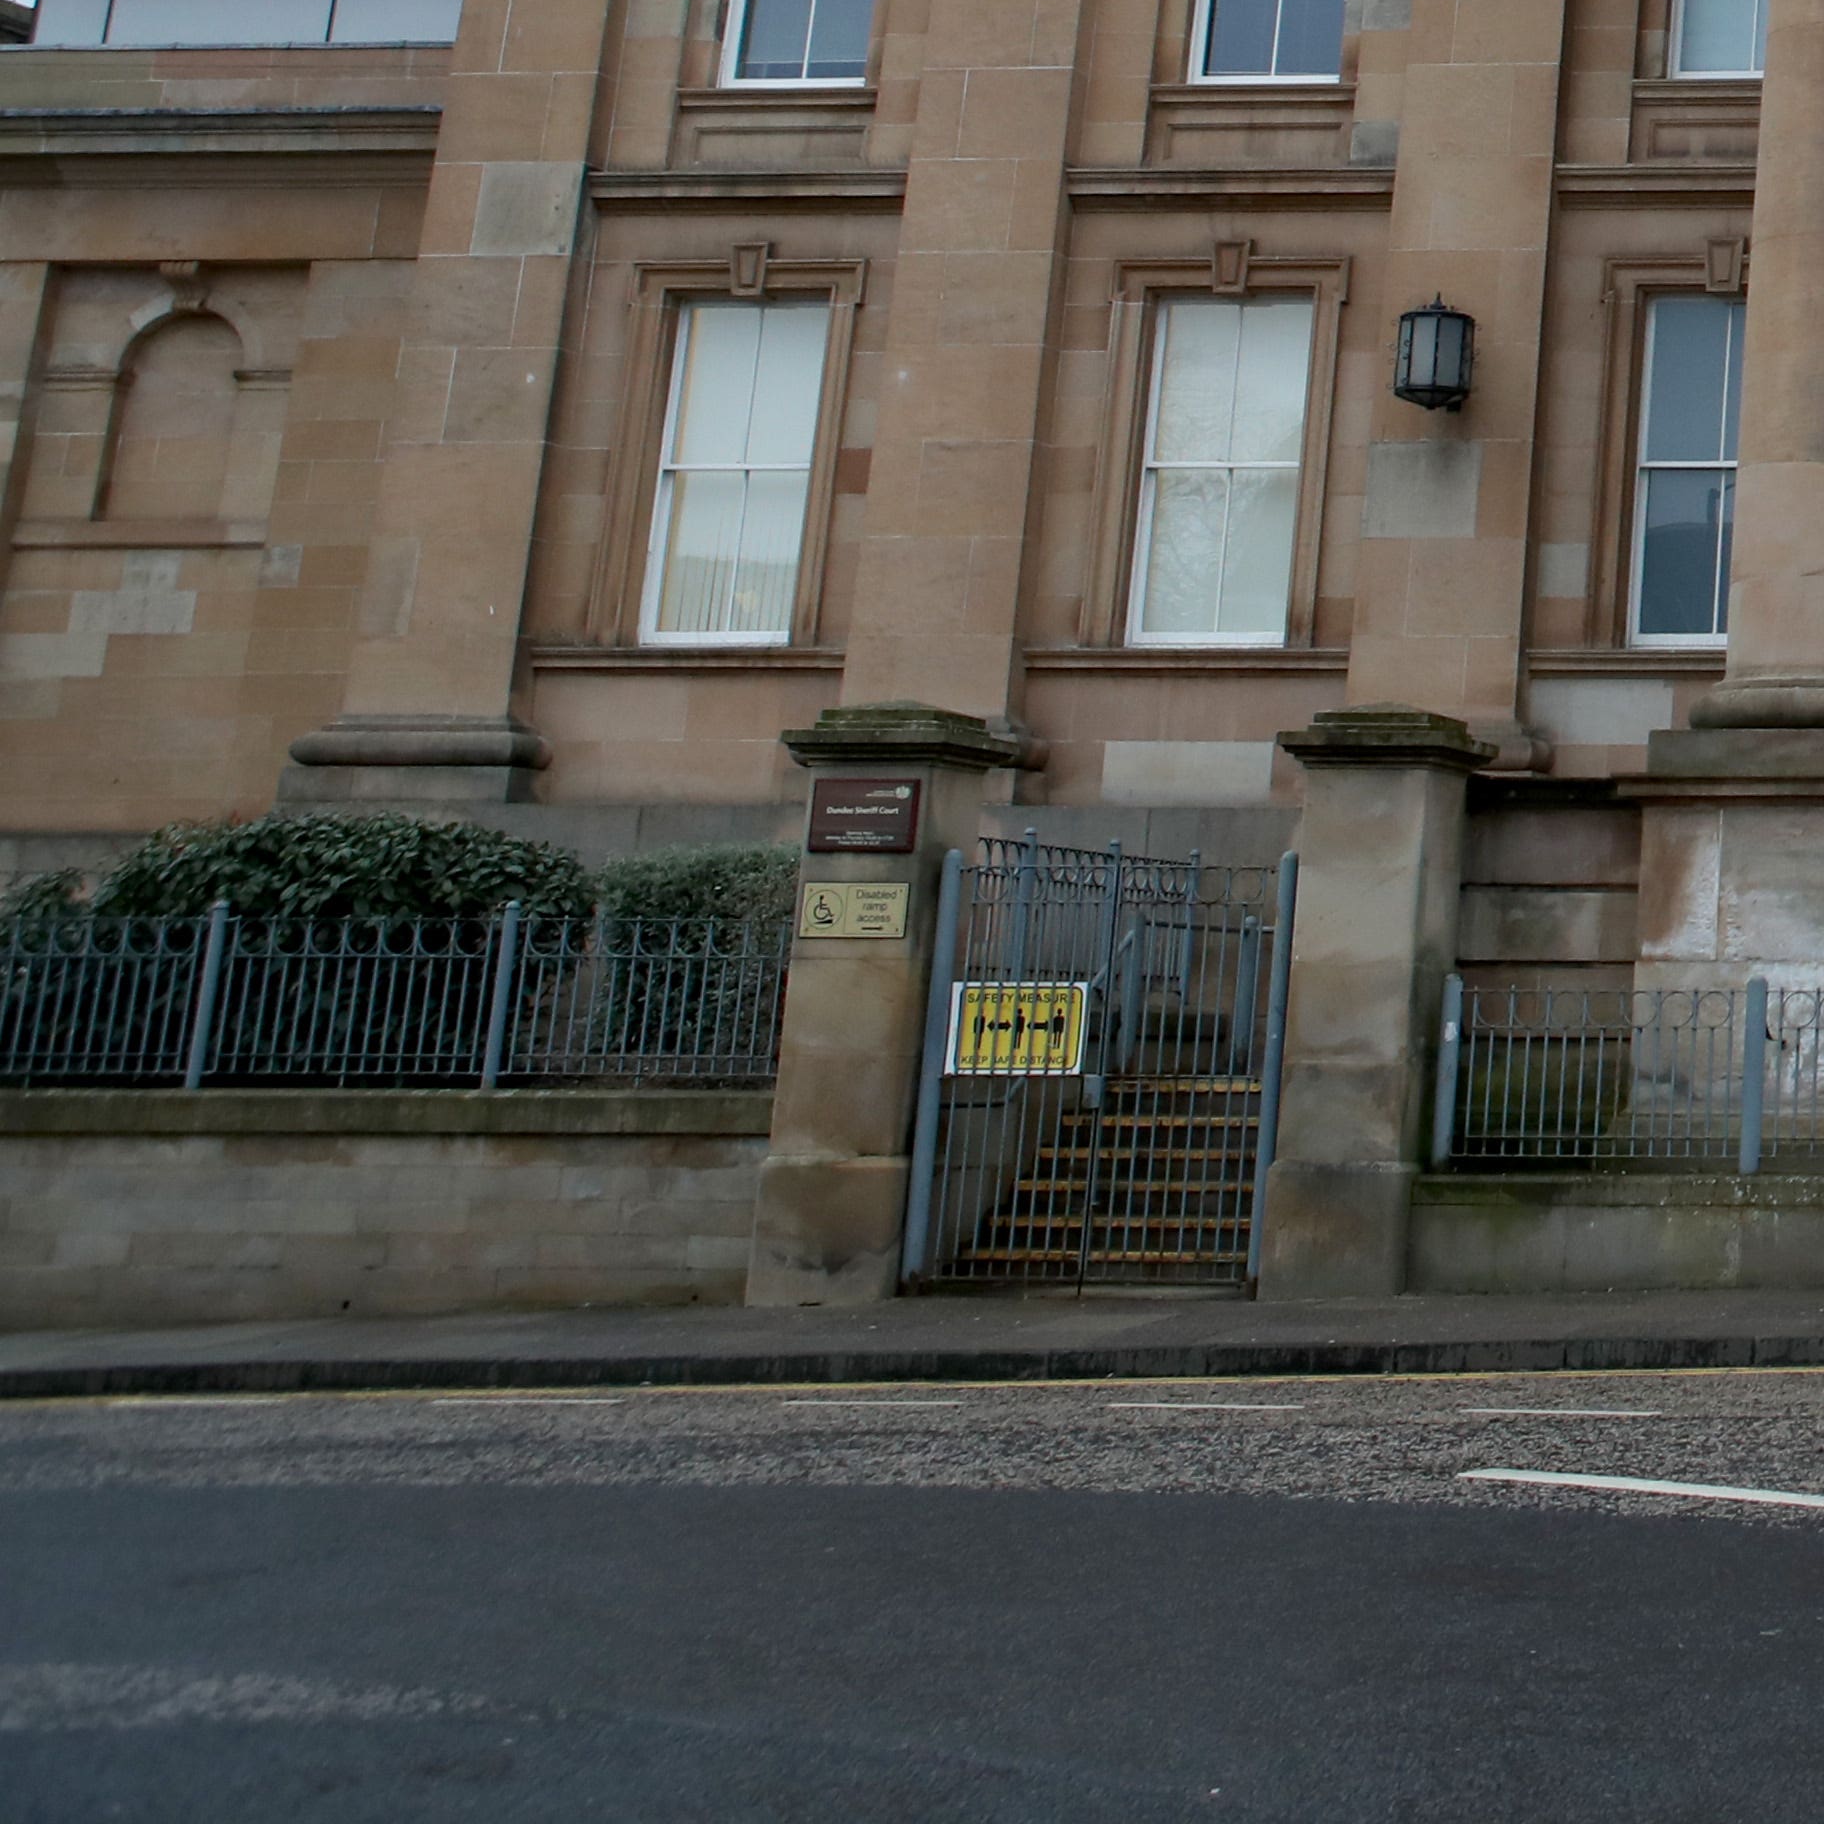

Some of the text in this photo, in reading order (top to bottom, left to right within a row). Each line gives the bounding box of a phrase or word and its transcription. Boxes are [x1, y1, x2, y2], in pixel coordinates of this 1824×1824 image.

[879, 806, 899, 814] Court
[856, 889, 897, 899] Disabled
[862, 903, 888, 913] ramp
[856, 915, 891, 923] access
